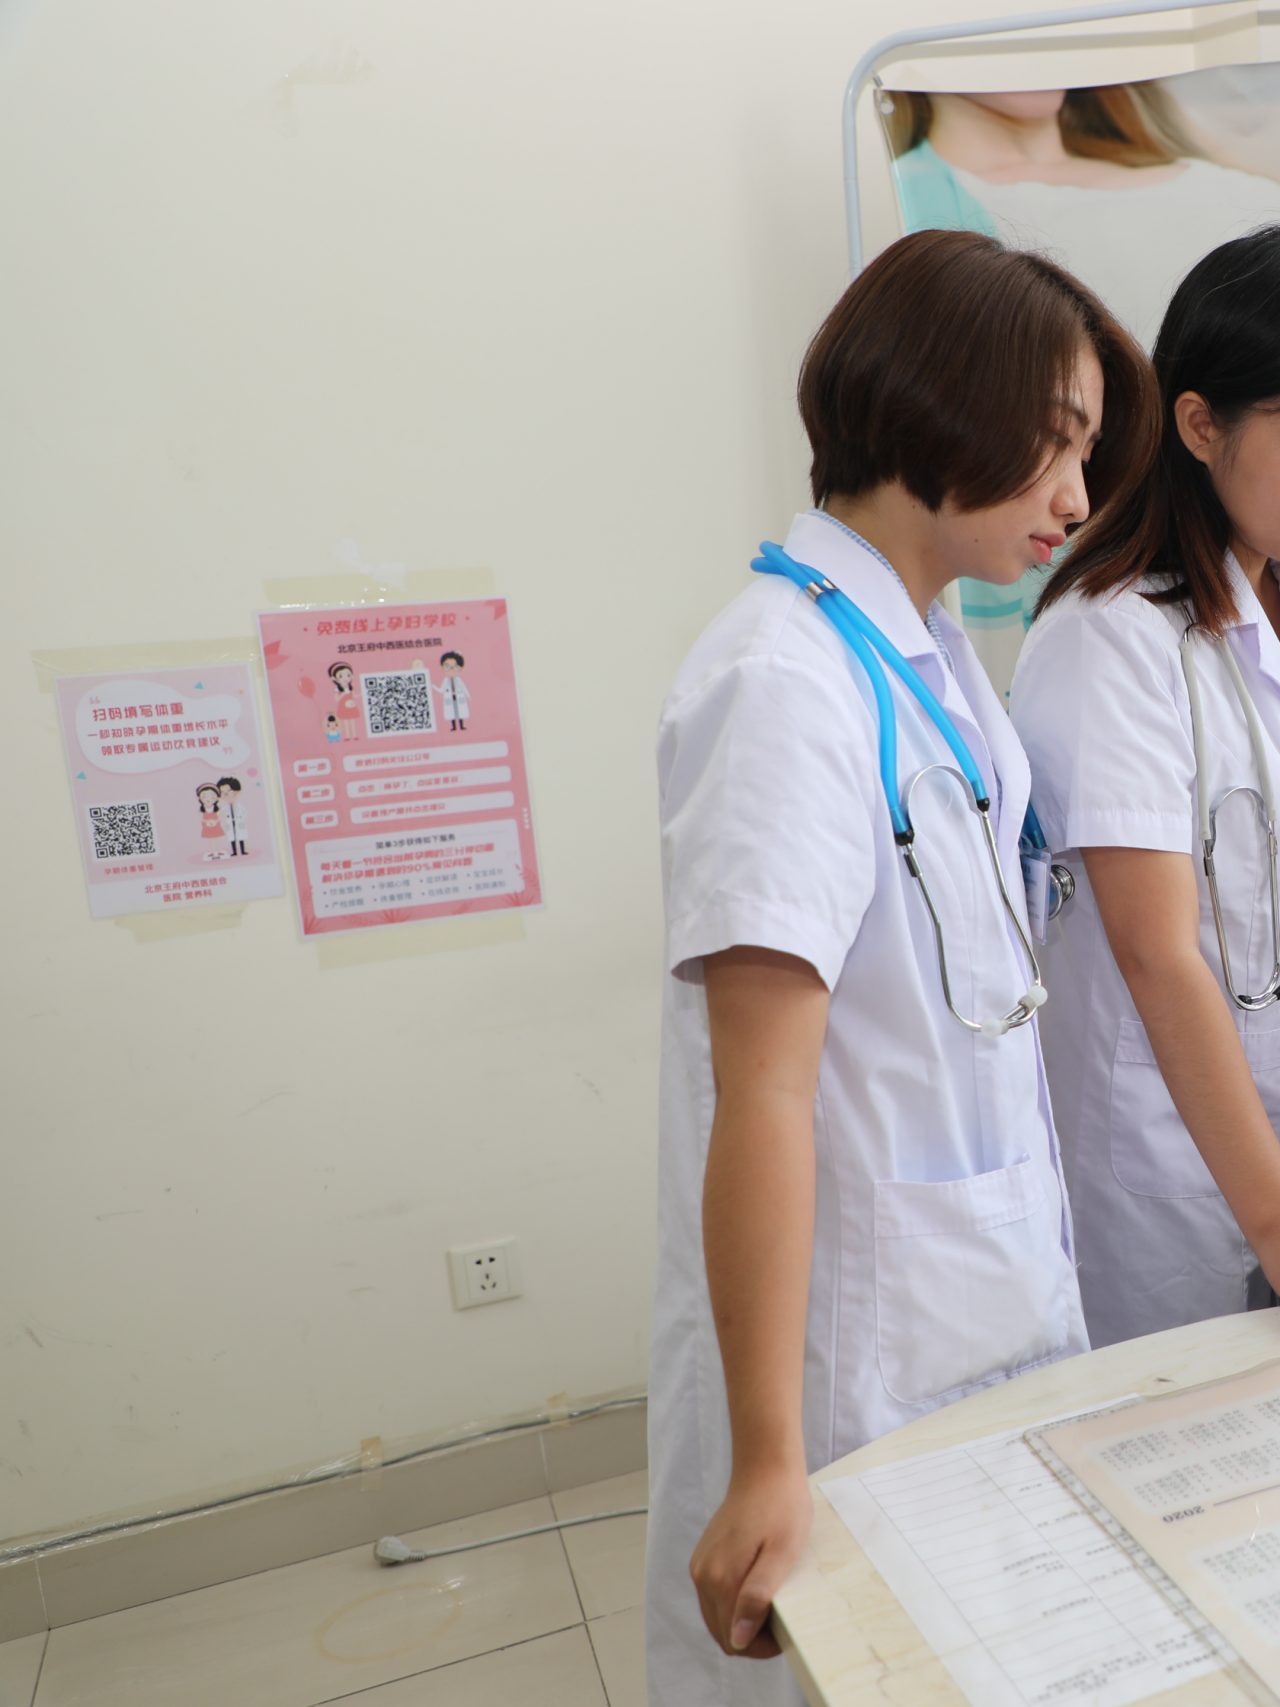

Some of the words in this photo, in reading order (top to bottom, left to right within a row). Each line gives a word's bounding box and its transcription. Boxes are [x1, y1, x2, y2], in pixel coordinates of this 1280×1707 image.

[92, 702, 184, 722] 扫码填写体重
[87, 719, 229, 740] 一秒知晓孕期体重增长水平
[101, 736, 221, 757] 领取专属运动饮食建议
[144, 876, 227, 894] 北京王府中西医结合
[1162, 1505, 1205, 1524] 2020
